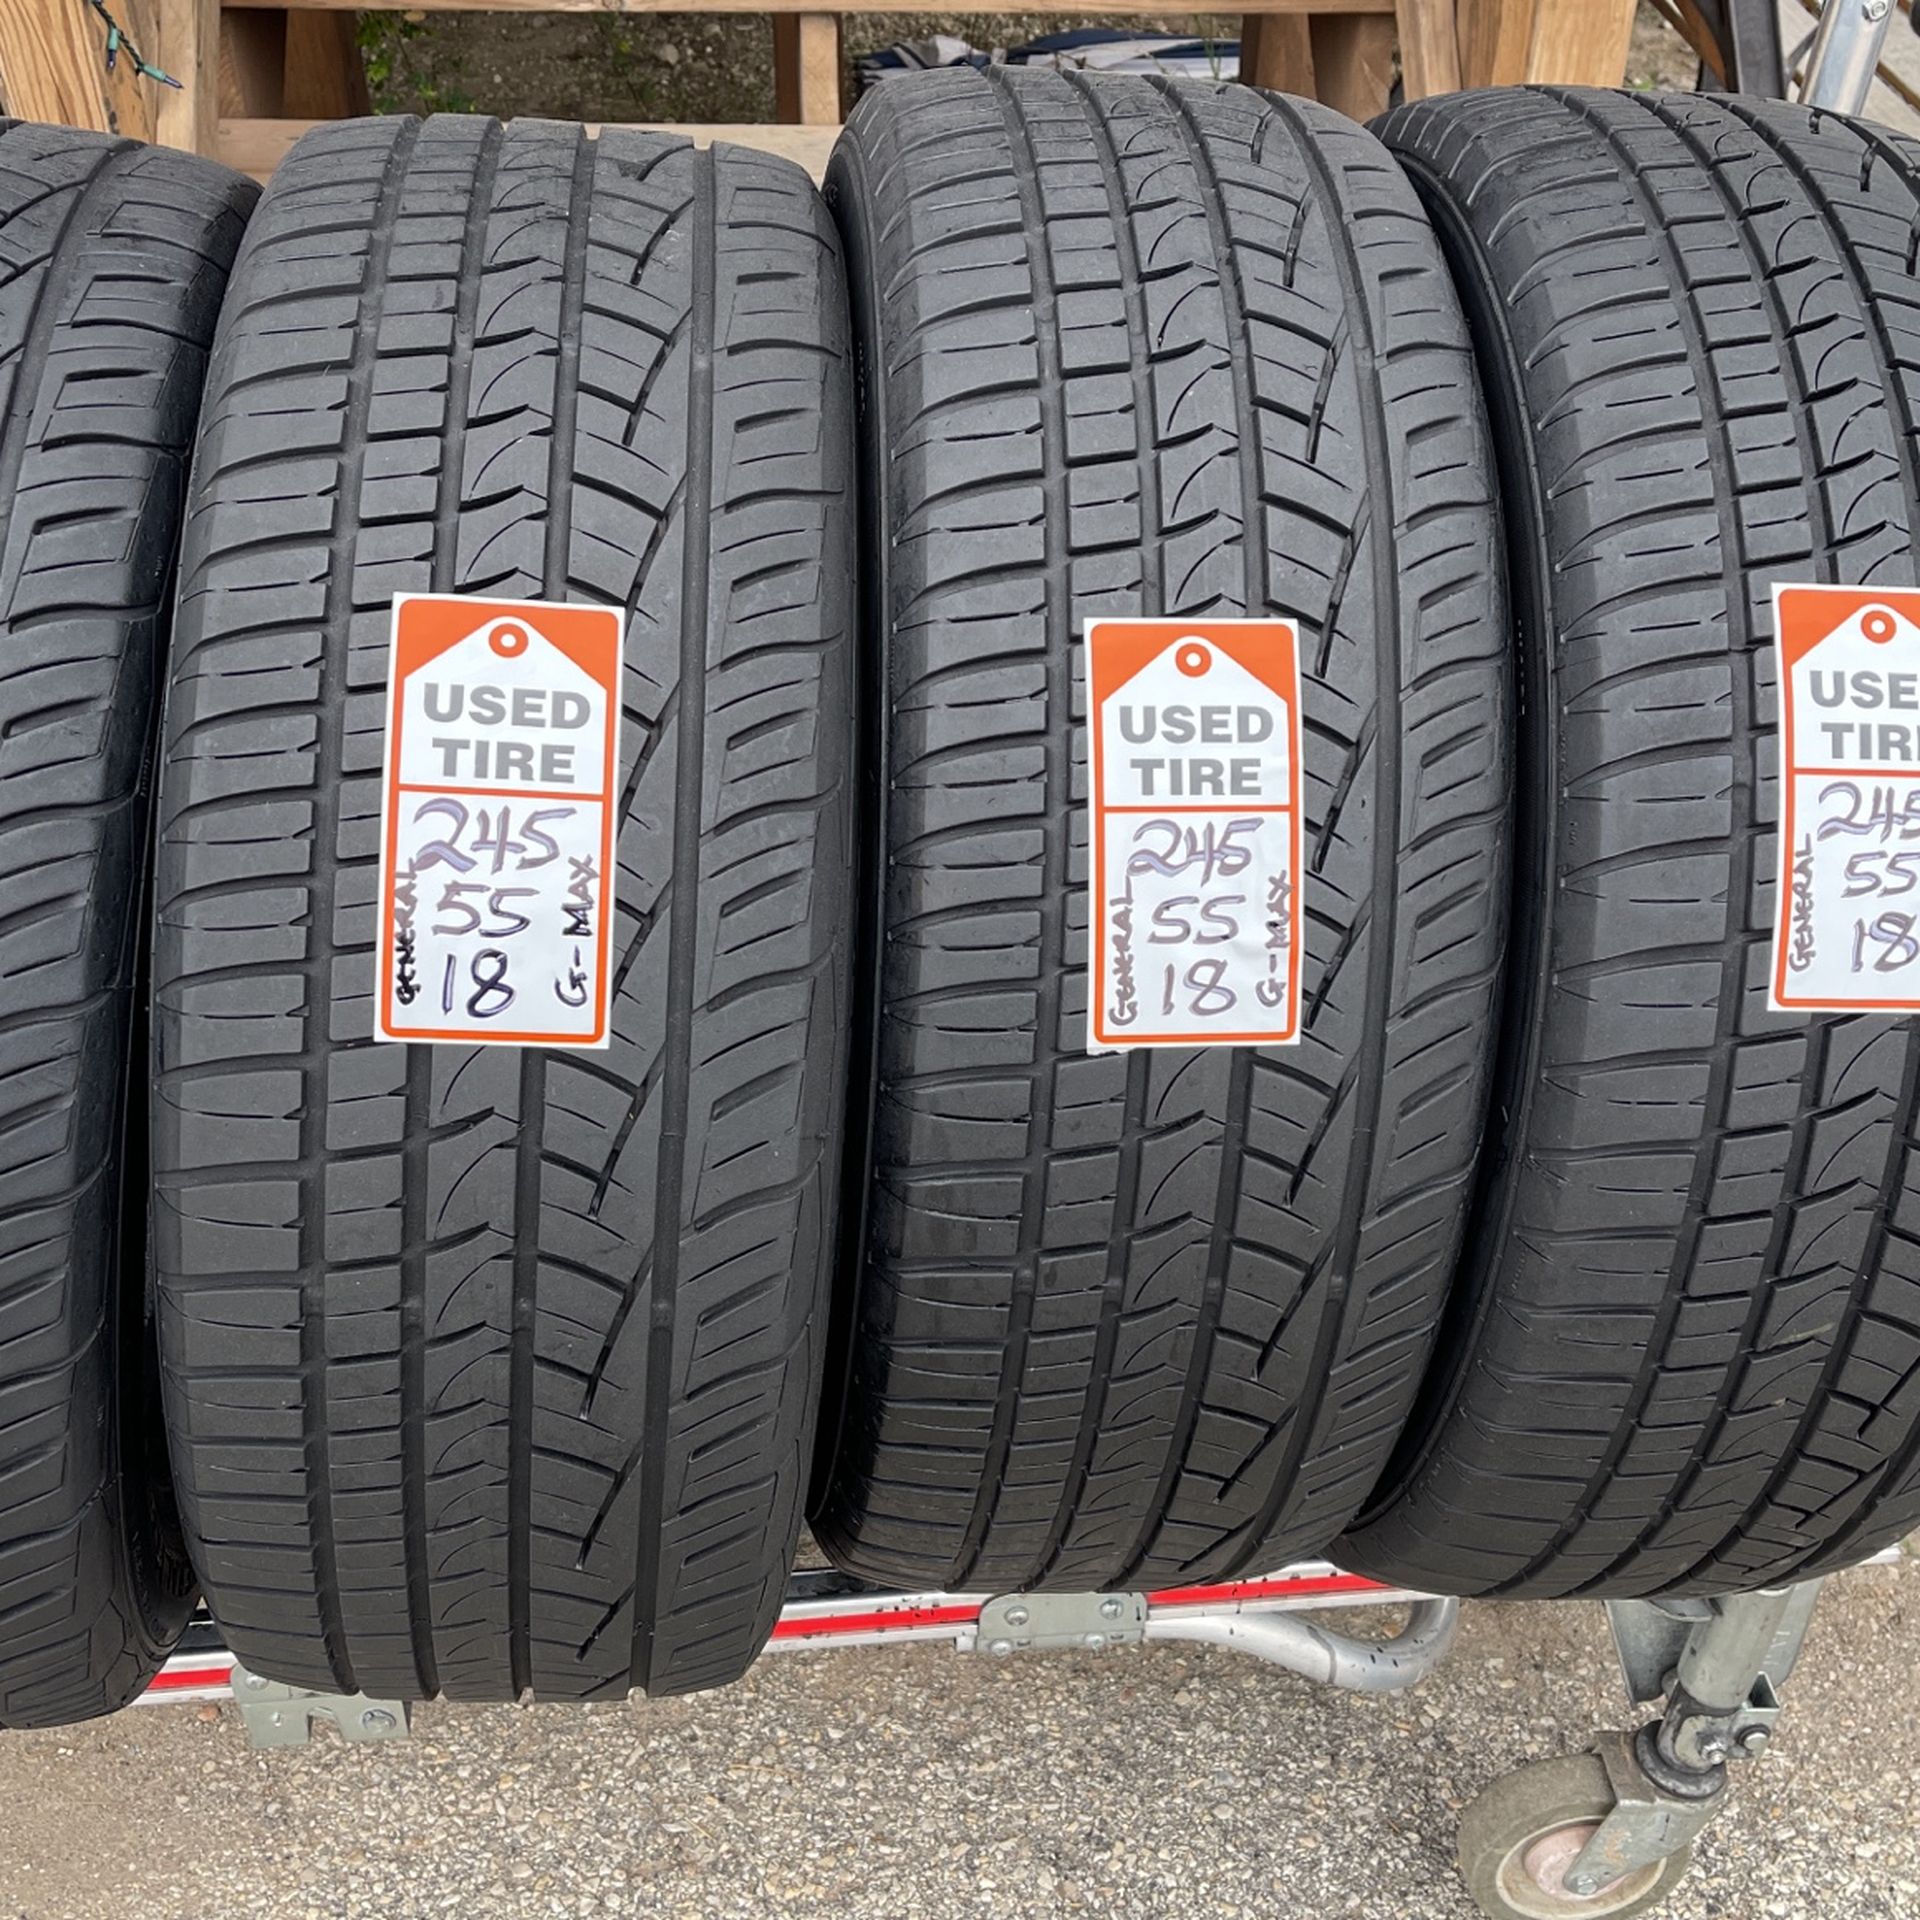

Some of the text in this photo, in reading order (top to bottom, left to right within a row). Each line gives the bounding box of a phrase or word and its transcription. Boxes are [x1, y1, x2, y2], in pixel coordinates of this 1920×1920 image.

[423, 682, 590, 730] USED
[1119, 705, 1274, 744] USED
[432, 737, 576, 784] TIRE
[1821, 722, 1920, 761] TIR
[1130, 758, 1262, 796] TIRE
[413, 797, 577, 875] 245
[1126, 817, 1264, 887] 245
[1840, 850, 1920, 898] 55
[432, 880, 540, 937] 55
[1147, 895, 1246, 945] 55
[1788, 833, 1816, 972] GENERAL
[1852, 911, 1920, 972] 18
[442, 948, 515, 1018] 18
[1162, 959, 1237, 1016] 18
